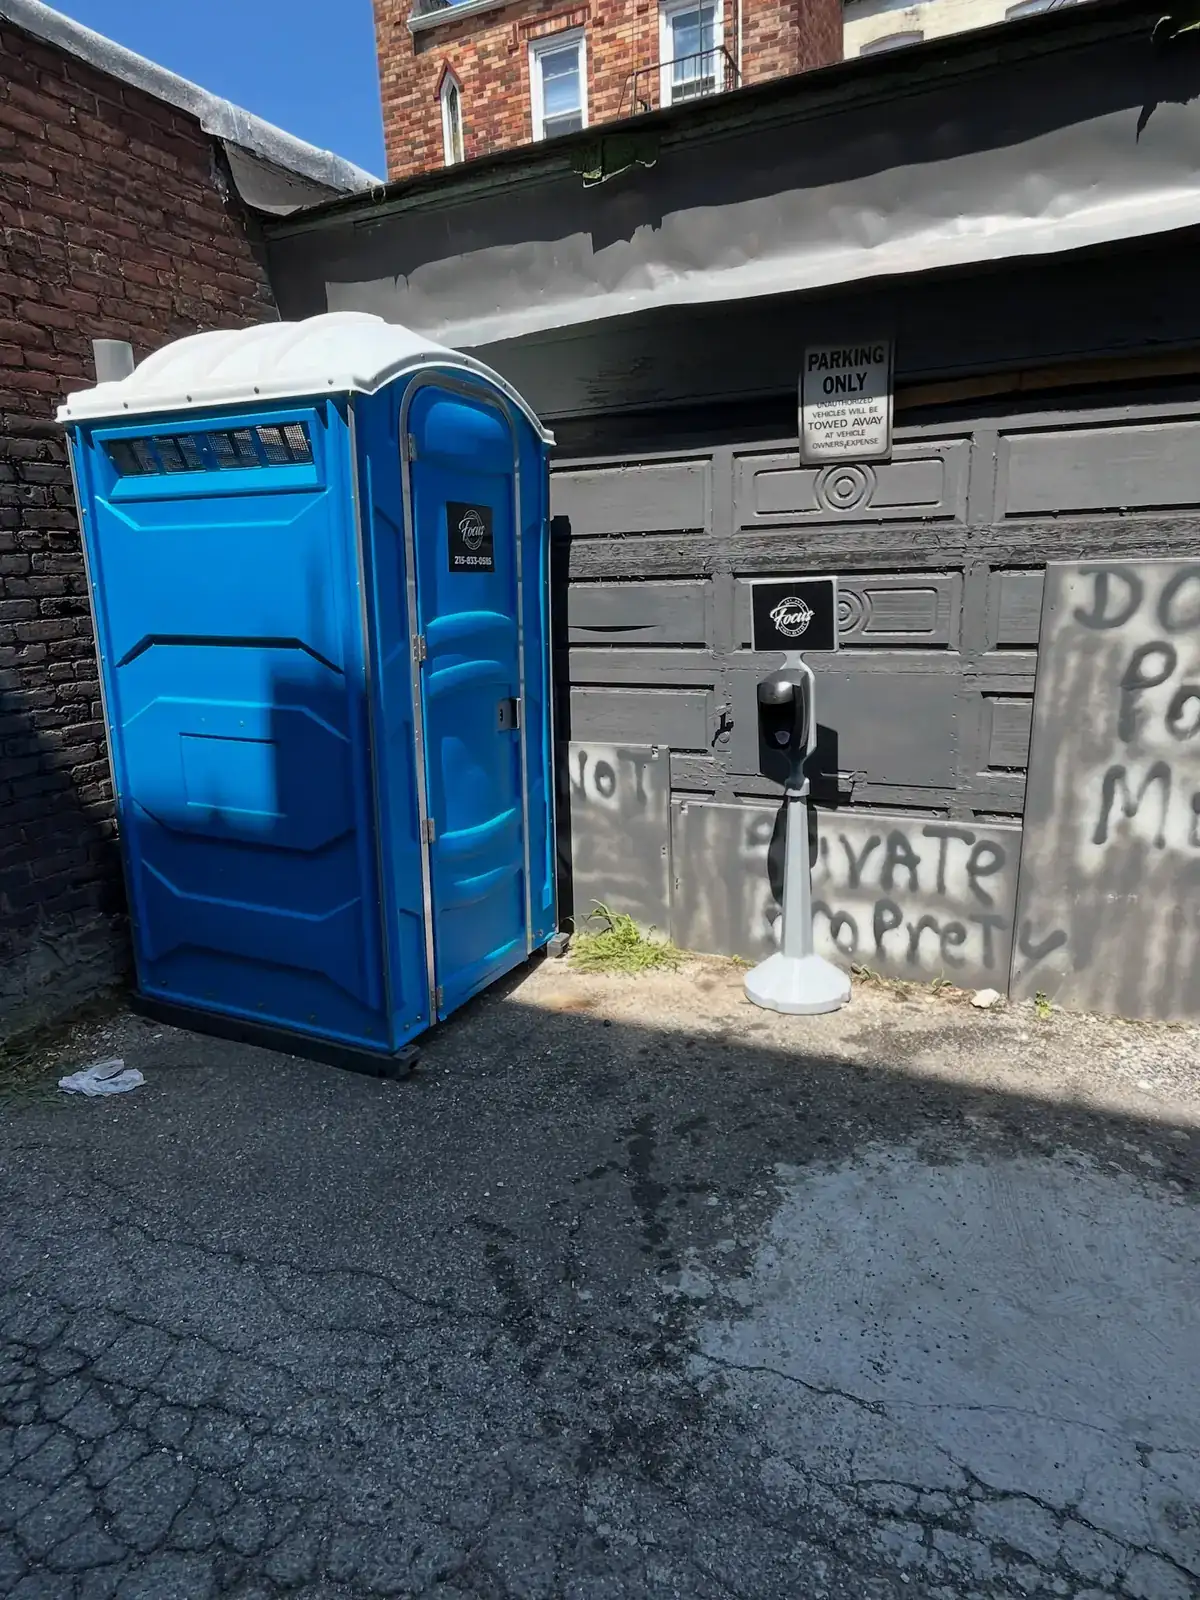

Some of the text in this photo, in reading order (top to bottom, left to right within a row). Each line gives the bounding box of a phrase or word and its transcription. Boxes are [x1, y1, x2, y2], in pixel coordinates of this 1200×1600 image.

[808, 345, 884, 372] PARKING
[823, 372, 867, 394] ONLY
[816, 397, 873, 408] UNAUTHORIZED
[812, 409, 846, 419] VEHICLES
[808, 416, 883, 431] TOWED AWAY
[836, 429, 866, 438] VEHICLE
[846, 437, 879, 447] EXPENSE
[458, 517, 485, 541] Focus
[769, 604, 815, 630] Focus
